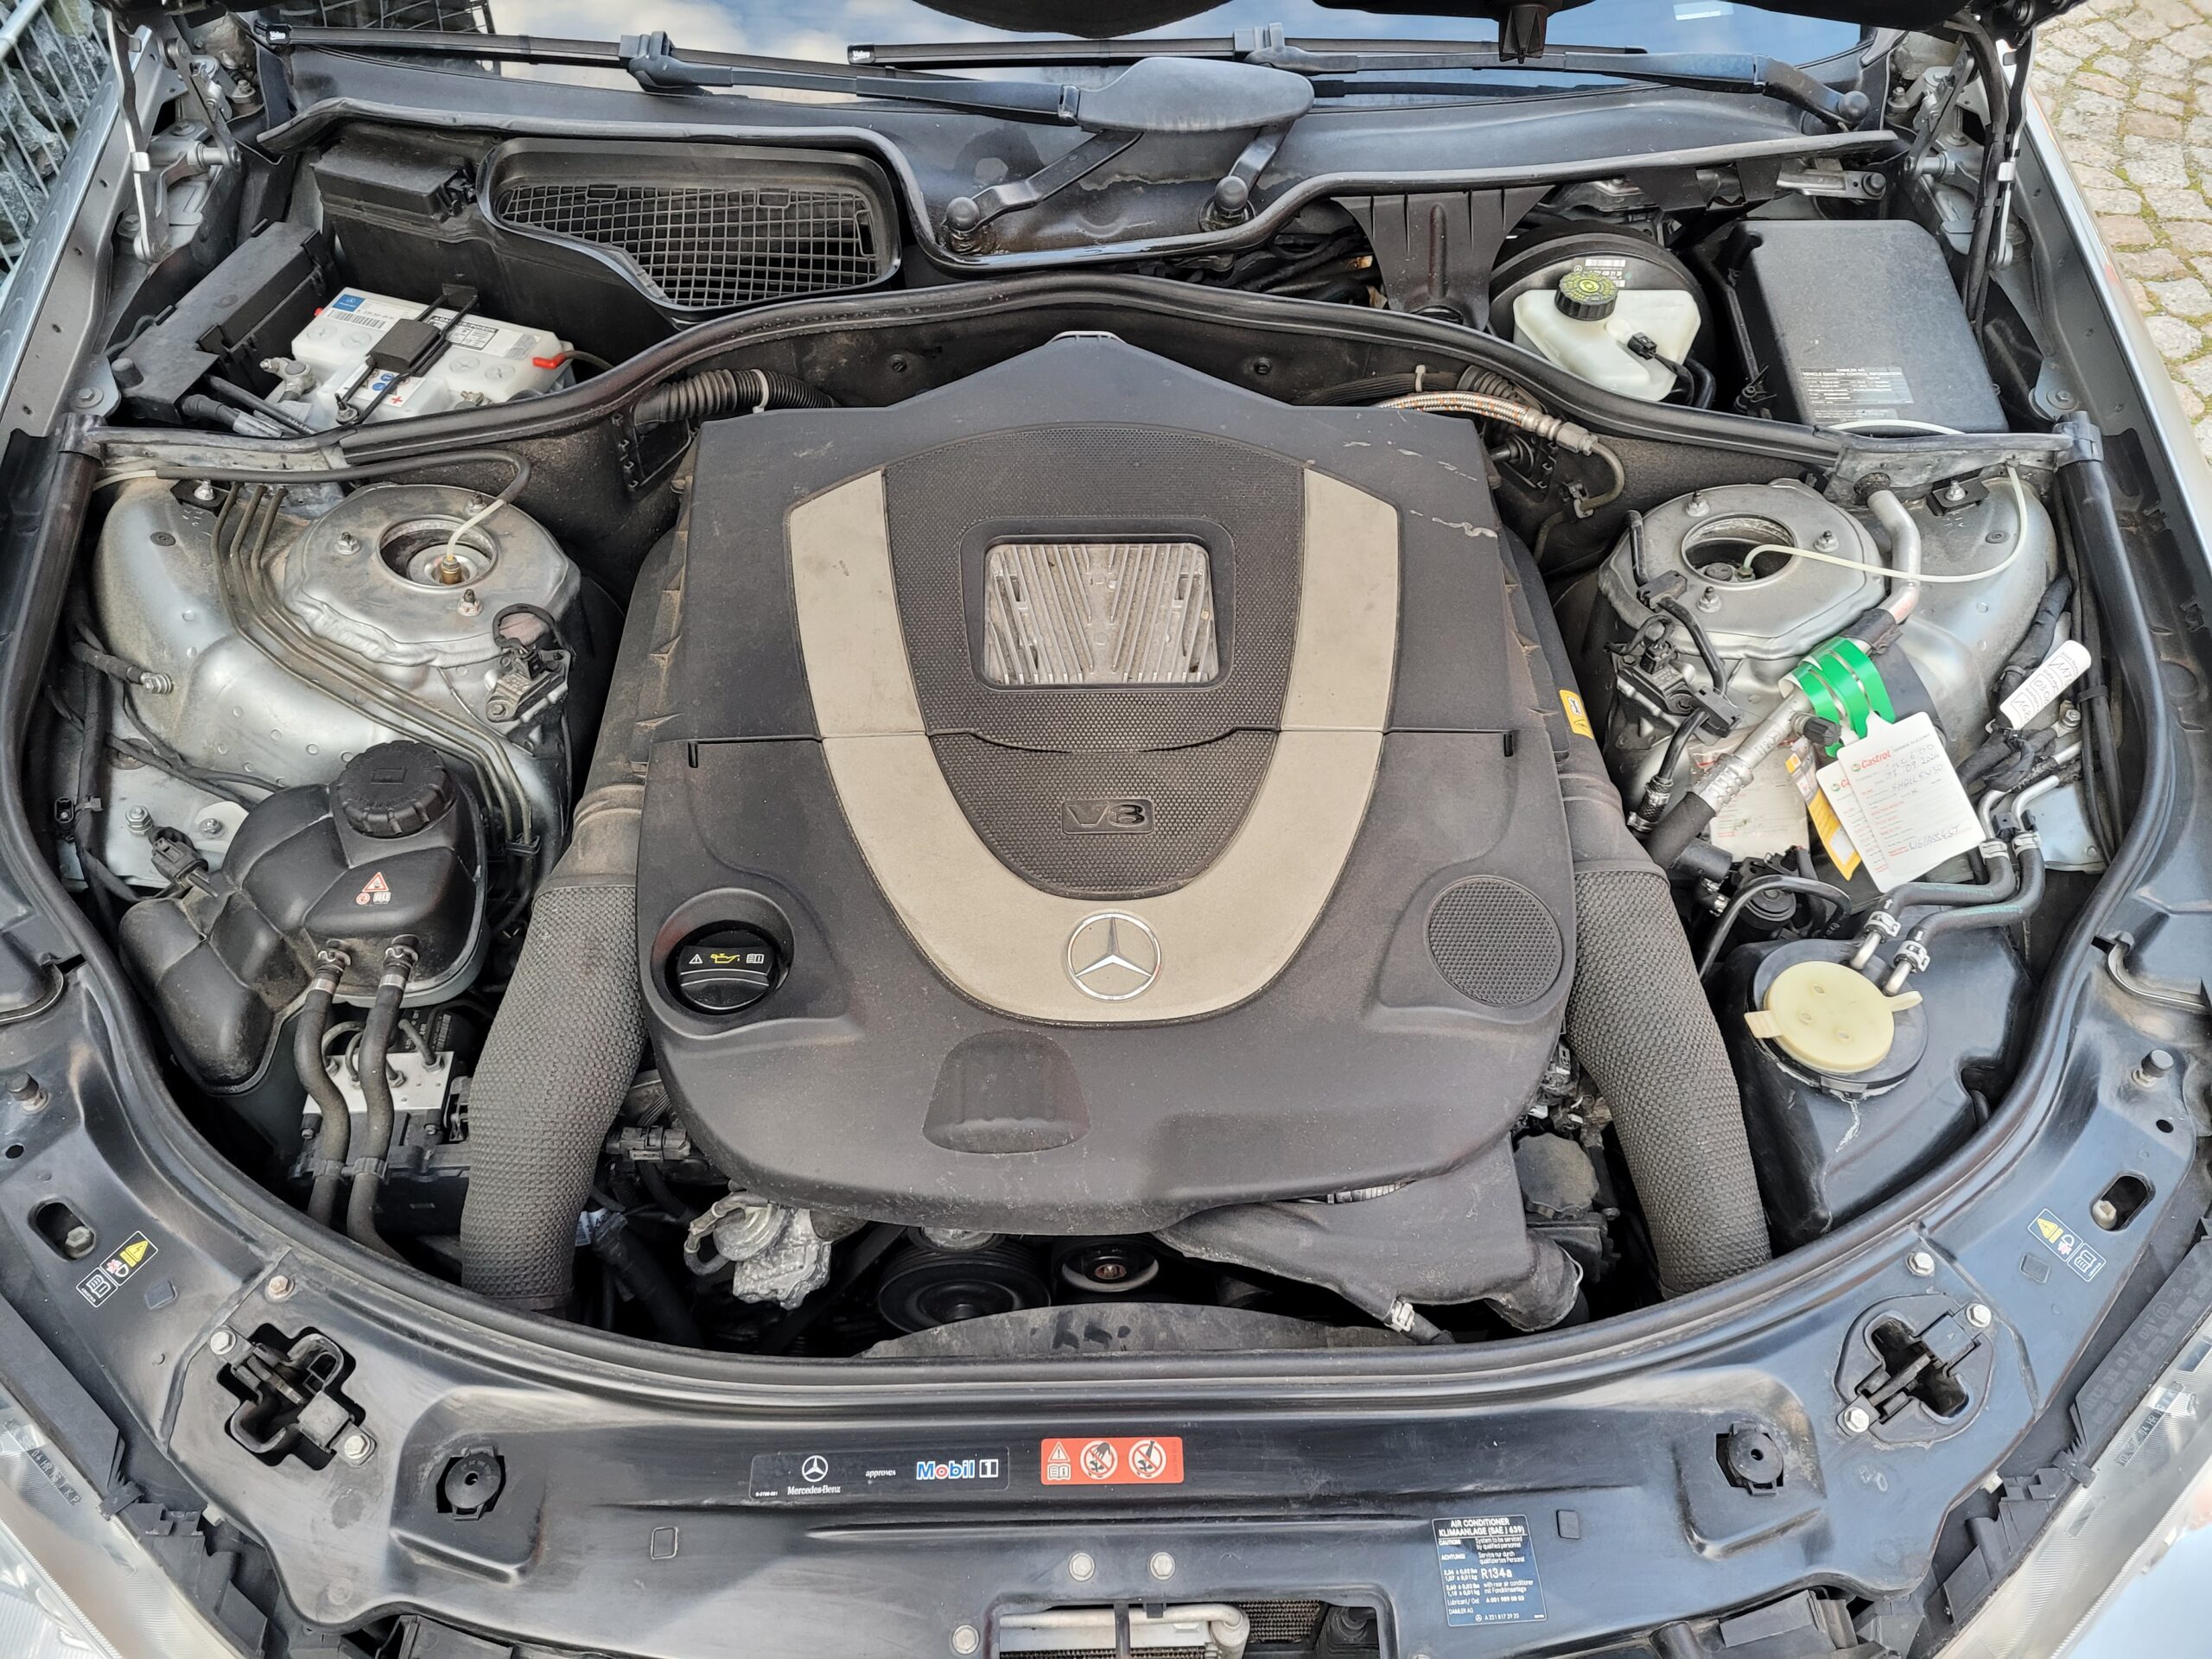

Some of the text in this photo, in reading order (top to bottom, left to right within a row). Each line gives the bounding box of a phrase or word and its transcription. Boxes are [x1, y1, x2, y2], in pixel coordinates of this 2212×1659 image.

[1861, 750, 1891, 769] Castrol
[865, 1469, 896, 1478] approves
[916, 1459, 975, 1480] Mobil
[787, 1484, 841, 1495] Mercedes-Benz
[1464, 1517, 1510, 1527] CONDITIONER
[1439, 1528, 1487, 1537] KLIMAANLAGE
[1480, 1567, 1513, 1580] R134a
